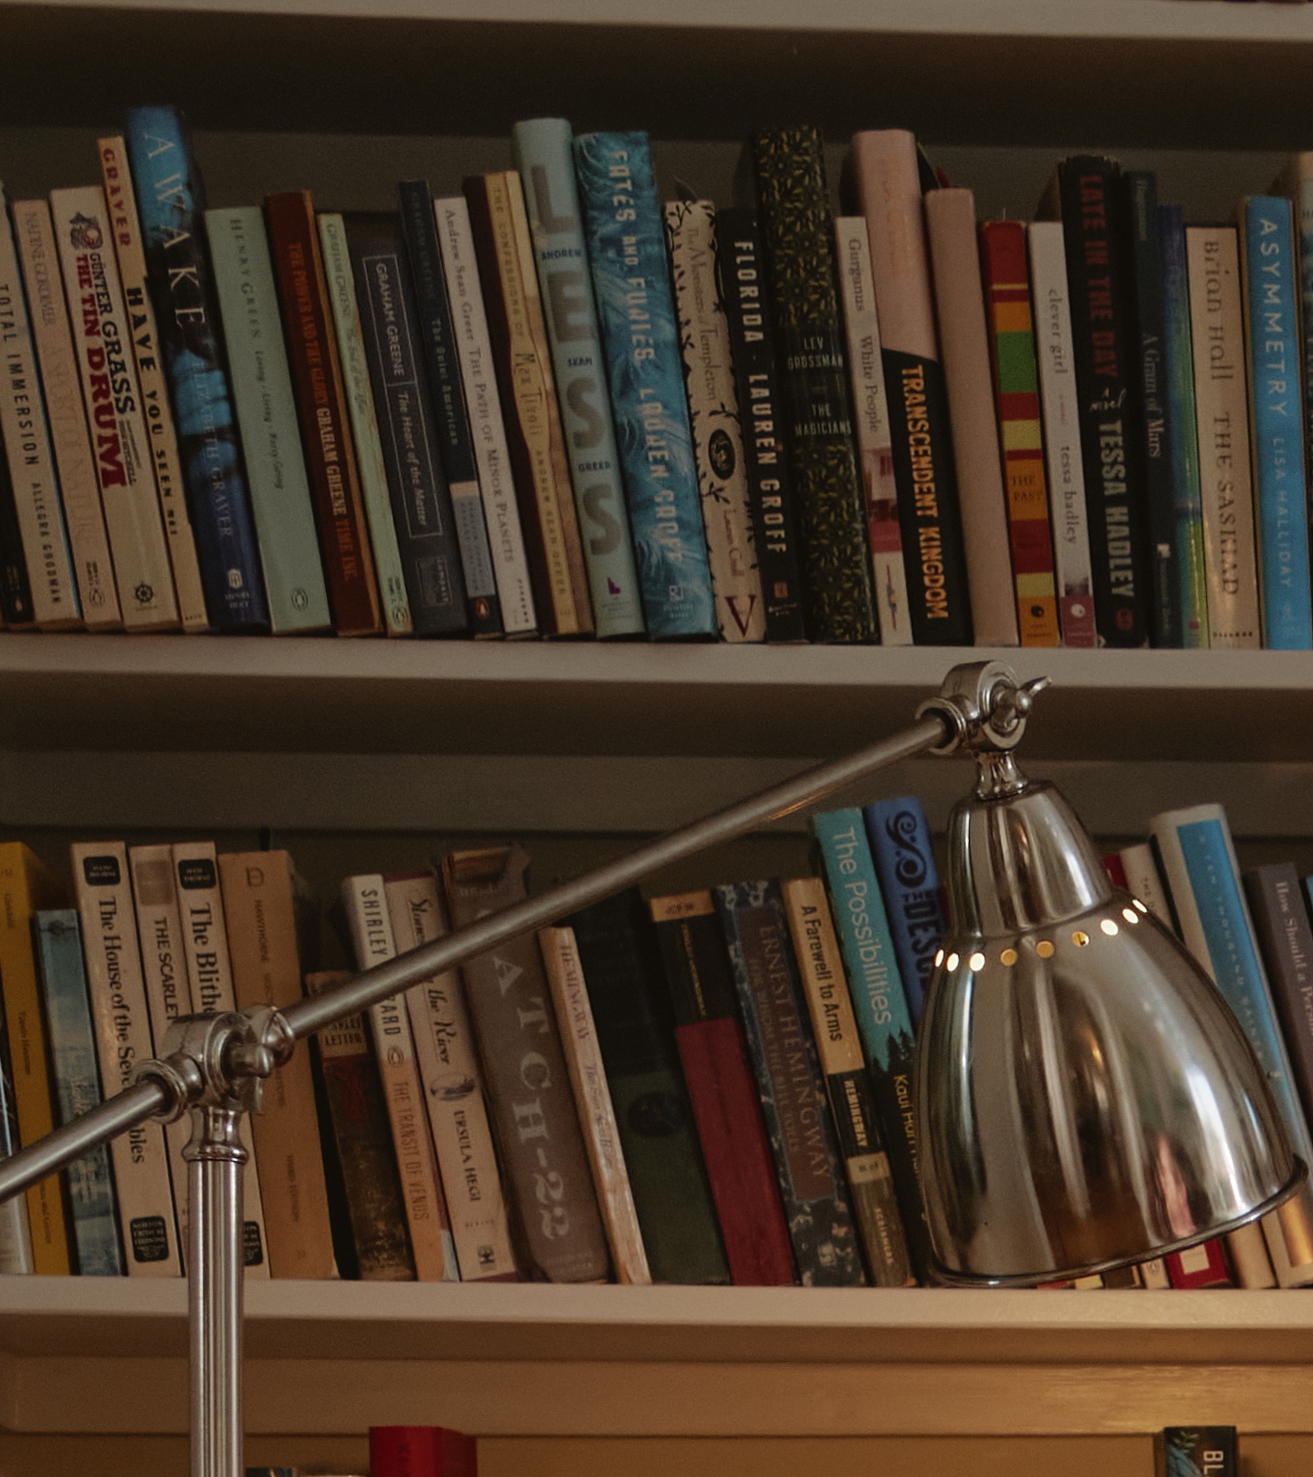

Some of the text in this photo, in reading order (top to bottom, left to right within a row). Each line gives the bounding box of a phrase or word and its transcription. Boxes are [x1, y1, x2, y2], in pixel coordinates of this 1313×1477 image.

[103, 148, 131, 247] GRAVER
[144, 132, 206, 330] AWAKE
[75, 254, 126, 488] THE TIN DRUM
[89, 252, 111, 314] GÜNTER
[102, 320, 135, 414] GRASS
[126, 287, 174, 498] HAVE YOU SEEN
[375, 263, 405, 377] GRAHAM GREENE
[607, 150, 682, 561] FATES AND FURIES LAUREN GROFF
[733, 240, 786, 553] FLORIDA LAUREN GROFF
[1258, 219, 1287, 417] ASYMMETRY
[0, 284, 62, 604] TOTAL IMMERSION ALLEGRA GOODMAN
[901, 364, 949, 619] TRANSCENDENT KINGDOM
[1099, 420, 1134, 598] TESSA HADLEY
[99, 897, 131, 1043] The House of the
[360, 889, 386, 957] SHIRLEY
[800, 905, 845, 1042] A Farewell to Arms
[832, 828, 895, 1025] The Possibilities
[1274, 881, 1294, 914] How
[1282, 917, 1308, 971] Should
[1295, 973, 1306, 982] a
